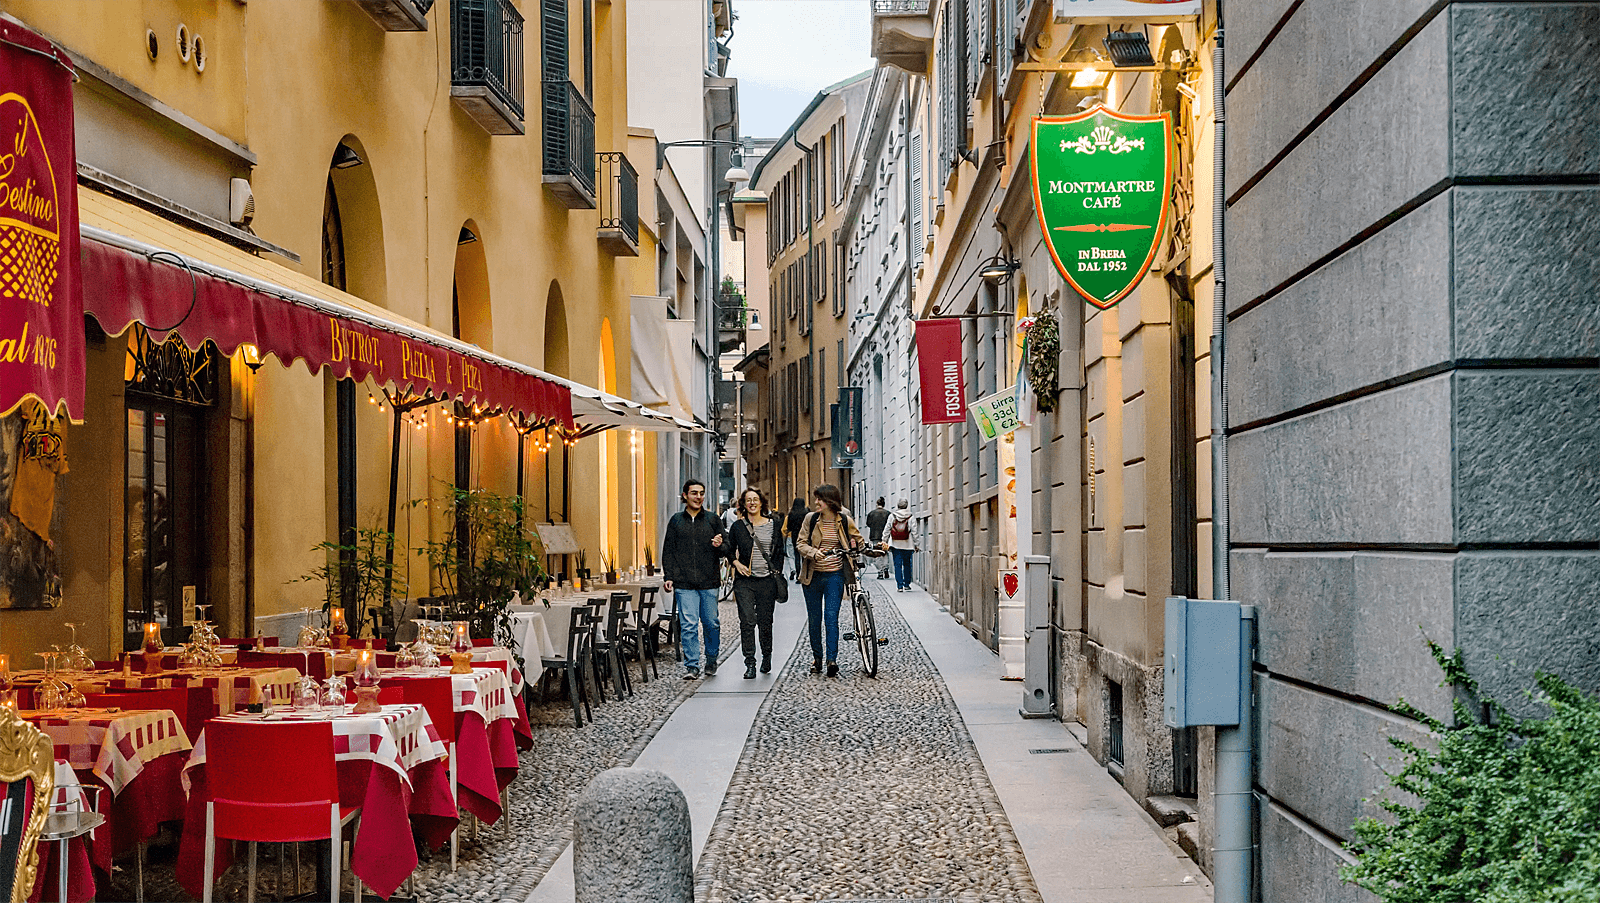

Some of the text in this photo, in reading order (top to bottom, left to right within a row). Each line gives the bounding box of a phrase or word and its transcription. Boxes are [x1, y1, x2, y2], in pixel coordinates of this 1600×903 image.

[14, 112, 28, 158] il
[1048, 180, 1156, 194] MONTMARTRE
[1082, 194, 1122, 209] CAFÉ
[1078, 247, 1126, 260] IN BRERA
[1078, 260, 1128, 272] DAL 1952
[0, 322, 57, 372] al 1976
[943, 360, 961, 417] FOSCARINI
[991, 396, 1015, 410] Birra
[992, 406, 1015, 421] 33cl
